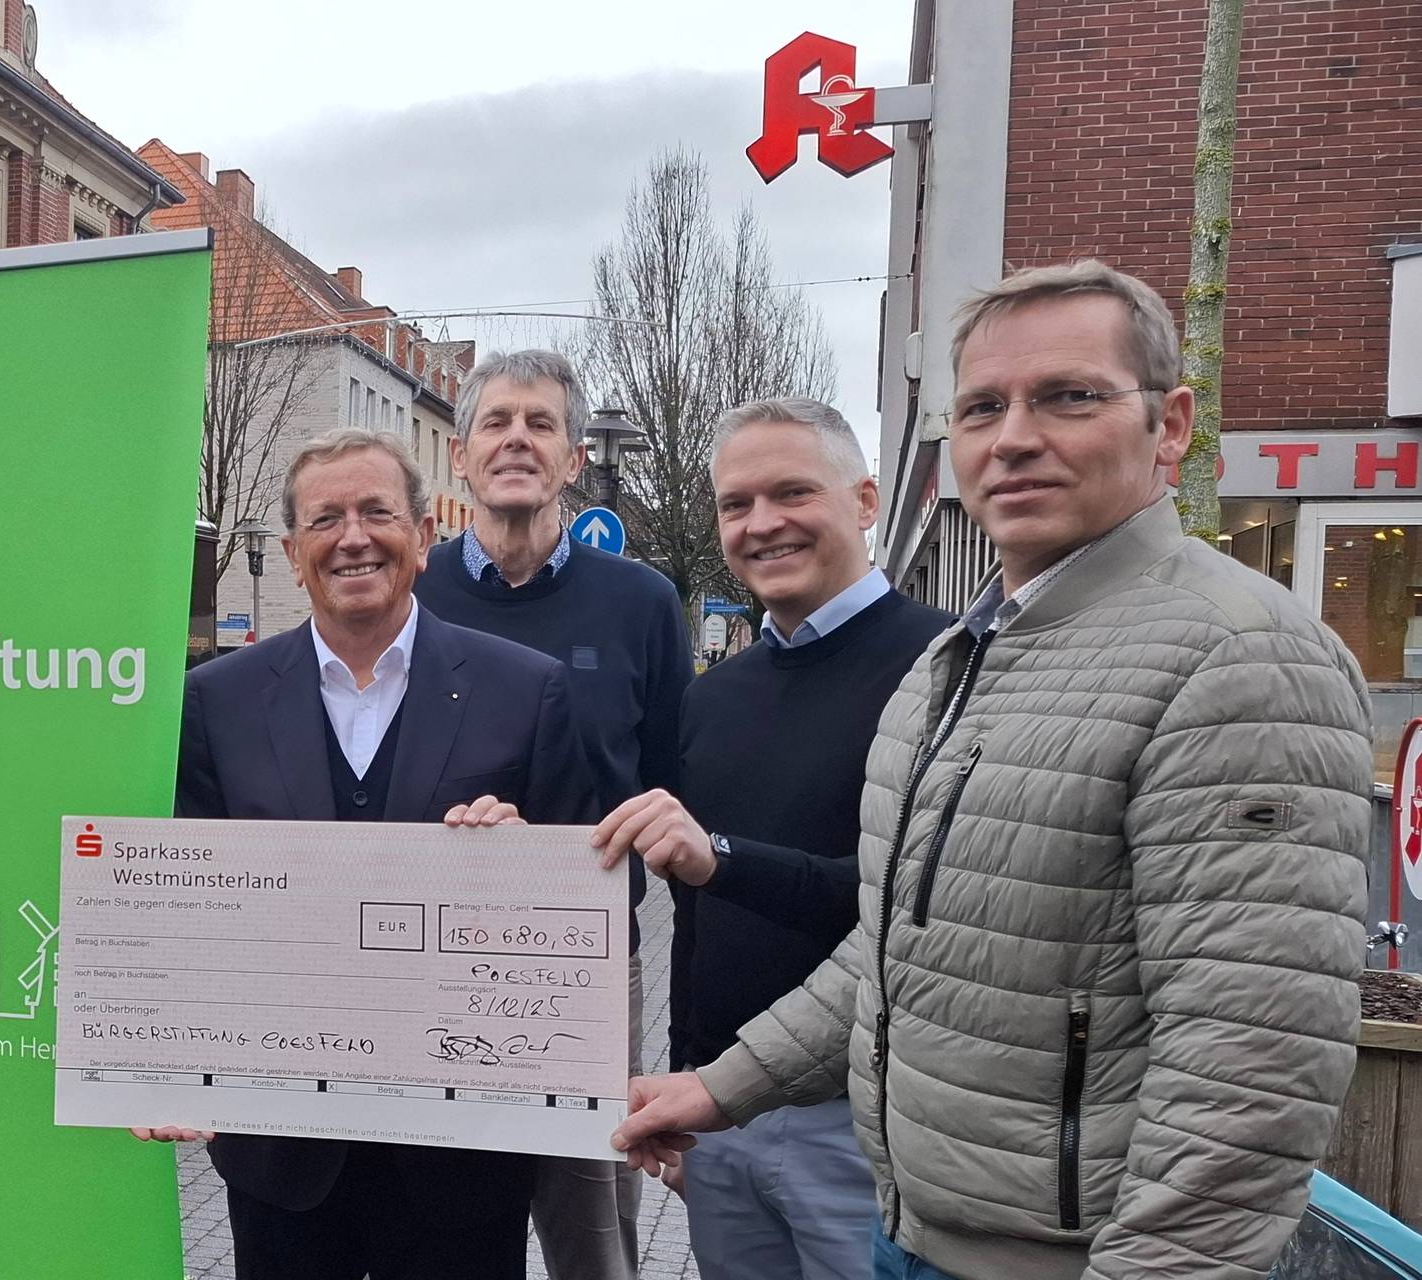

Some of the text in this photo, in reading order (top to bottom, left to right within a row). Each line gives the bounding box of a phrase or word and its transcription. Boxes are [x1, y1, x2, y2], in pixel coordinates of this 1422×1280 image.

[113, 842, 213, 862] Sparkasse
[113, 868, 288, 890] Westmünsterland
[76, 896, 243, 912] Zahlen Sie gegen diesen Scheck
[509, 904, 529, 912] Cent
[378, 921, 408, 932] EUR
[444, 927, 489, 945] 150
[75, 938, 99, 946] Betrag
[108, 938, 150, 947] Buchstaben
[94, 970, 117, 979] Betrag
[127, 971, 169, 980] Buchstaben
[438, 983, 497, 994] Ausstellungsort
[73, 991, 87, 999] an
[73, 1002, 161, 1016] oder Überbringer
[467, 994, 570, 1019] 8/12/25
[438, 1016, 464, 1026] Datum
[89, 1059, 102, 1067] Der
[103, 1060, 146, 1069] vorgedruckte
[147, 1061, 184, 1070] Schecktext
[185, 1063, 199, 1071] darf
[200, 1064, 216, 1072] nicht
[249, 1066, 265, 1074] oder
[266, 1067, 301, 1077] gestrichen
[331, 1070, 344, 1078] Die
[344, 1071, 372, 1081] Angabe
[373, 1073, 392, 1081] einer
[439, 1077, 451, 1085] auf
[452, 1078, 469, 1086] dem
[470, 1079, 497, 1088] Scheck
[510, 1081, 522, 1090] als
[523, 1082, 541, 1091] nicht
[251, 1079, 289, 1089] Konto-Nr.
[378, 1085, 404, 1096] Betrag
[481, 1092, 531, 1104] Bankleitzahl
[568, 1099, 587, 1108] Text
[211, 1119, 456, 1143] Bitte dieses Feld nicht beschriften und nicht bestempeln
